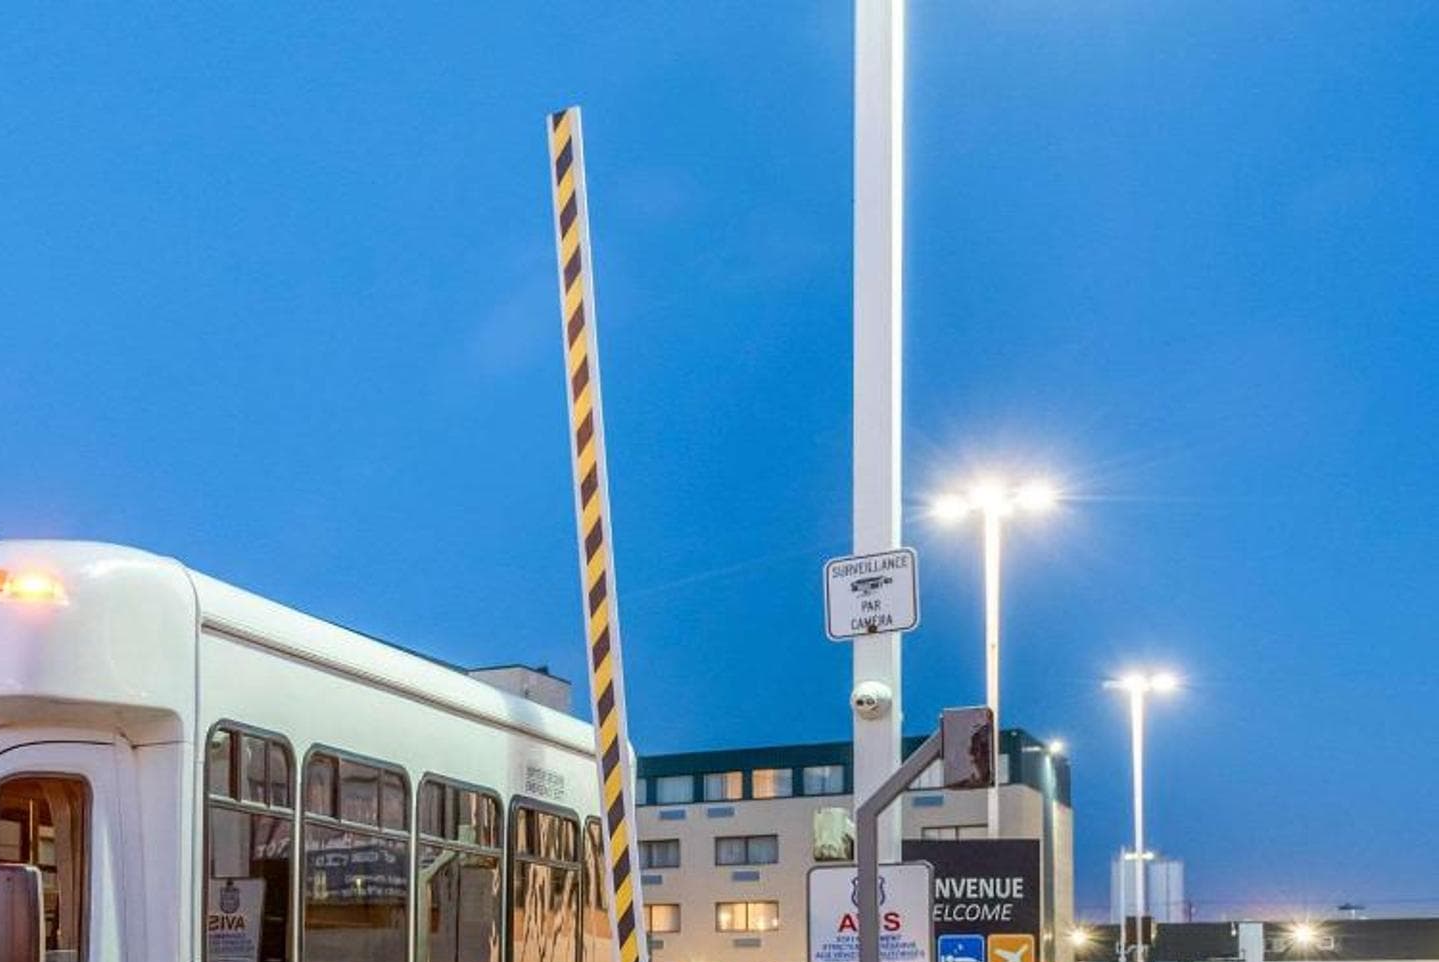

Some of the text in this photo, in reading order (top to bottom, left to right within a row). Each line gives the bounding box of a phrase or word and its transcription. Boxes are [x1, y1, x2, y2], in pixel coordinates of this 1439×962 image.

[832, 556, 907, 578] SURVEILLANCE
[861, 600, 881, 613] PAR
[935, 877, 1024, 899] NVENUE
[838, 912, 901, 932] AS
[933, 904, 1014, 921] ELCOME
